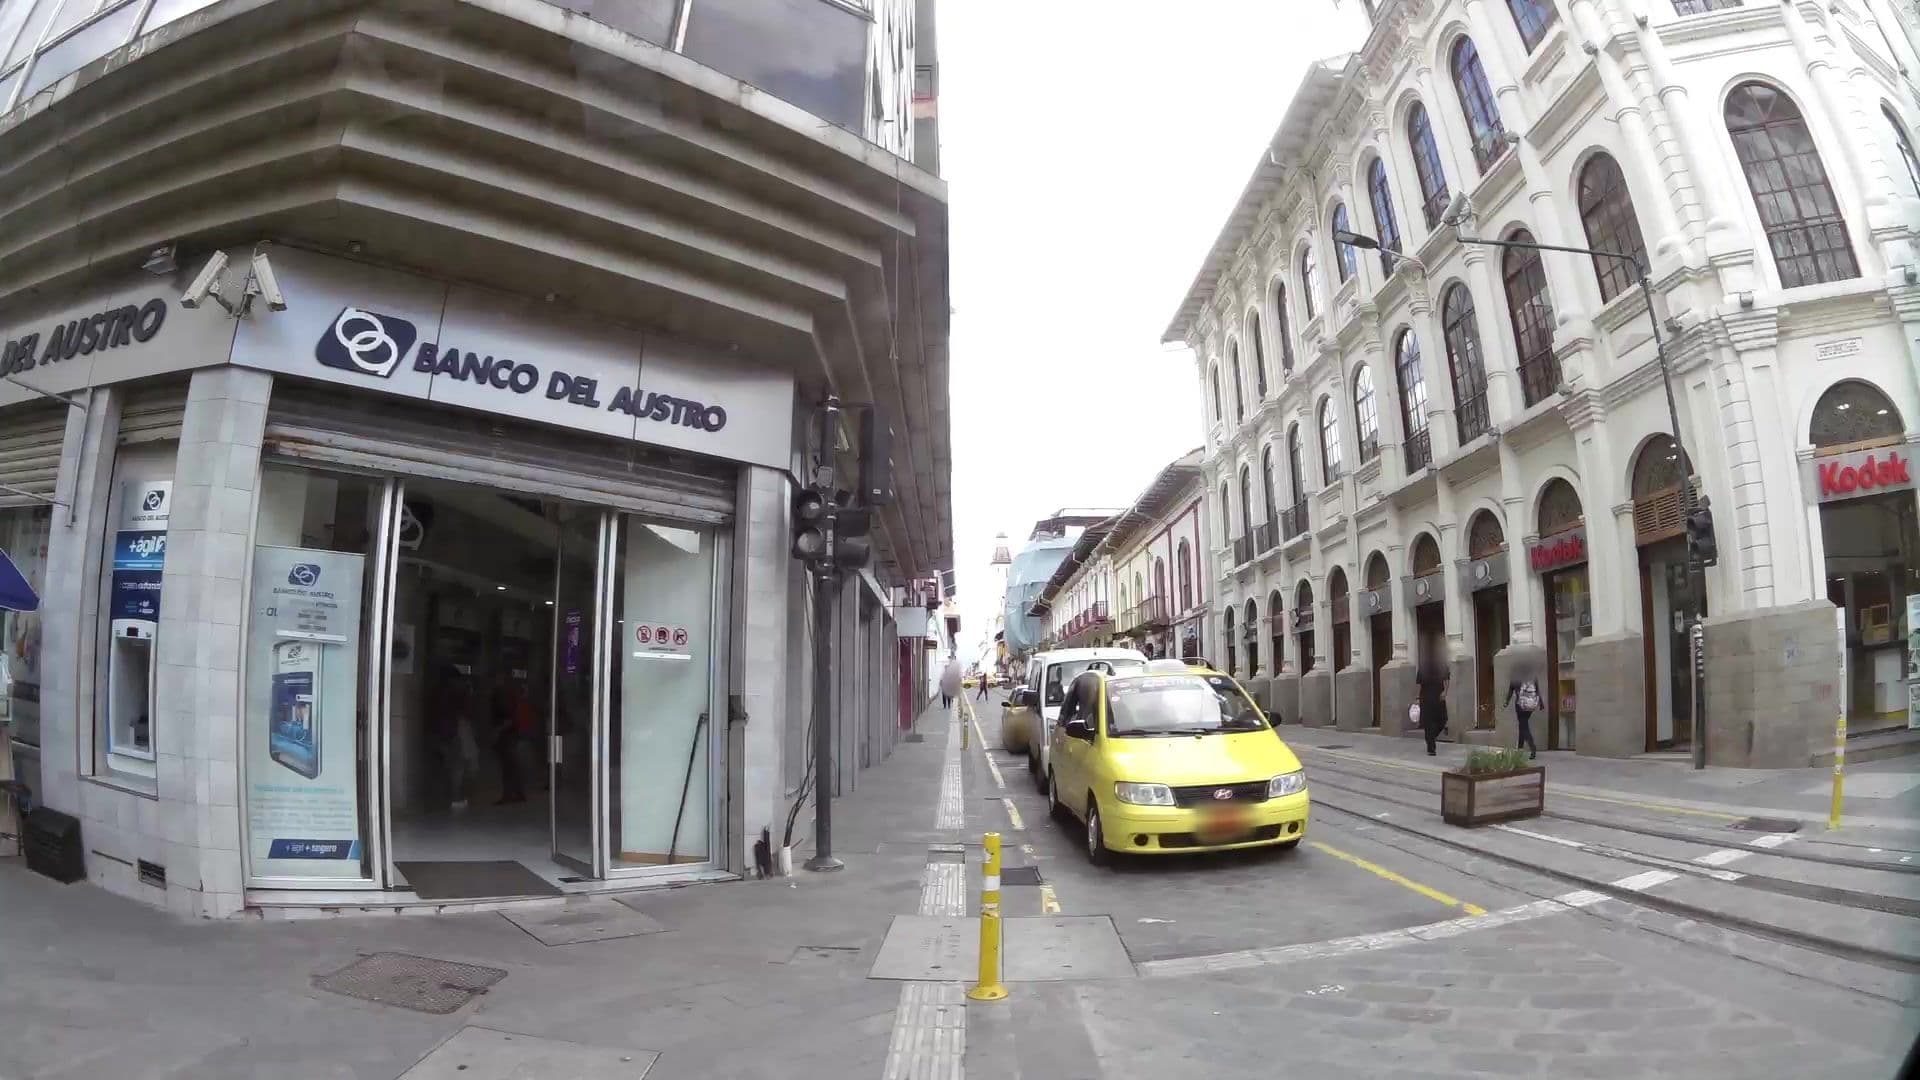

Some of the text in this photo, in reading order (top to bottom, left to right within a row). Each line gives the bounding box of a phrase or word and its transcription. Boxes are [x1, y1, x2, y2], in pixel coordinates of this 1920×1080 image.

[0, 298, 167, 377] DEL AUSTRO
[414, 342, 727, 432] BANCO DEL AUSTRO
[1818, 452, 1911, 495] Kodak
[1531, 536, 1584, 570] Kodak
